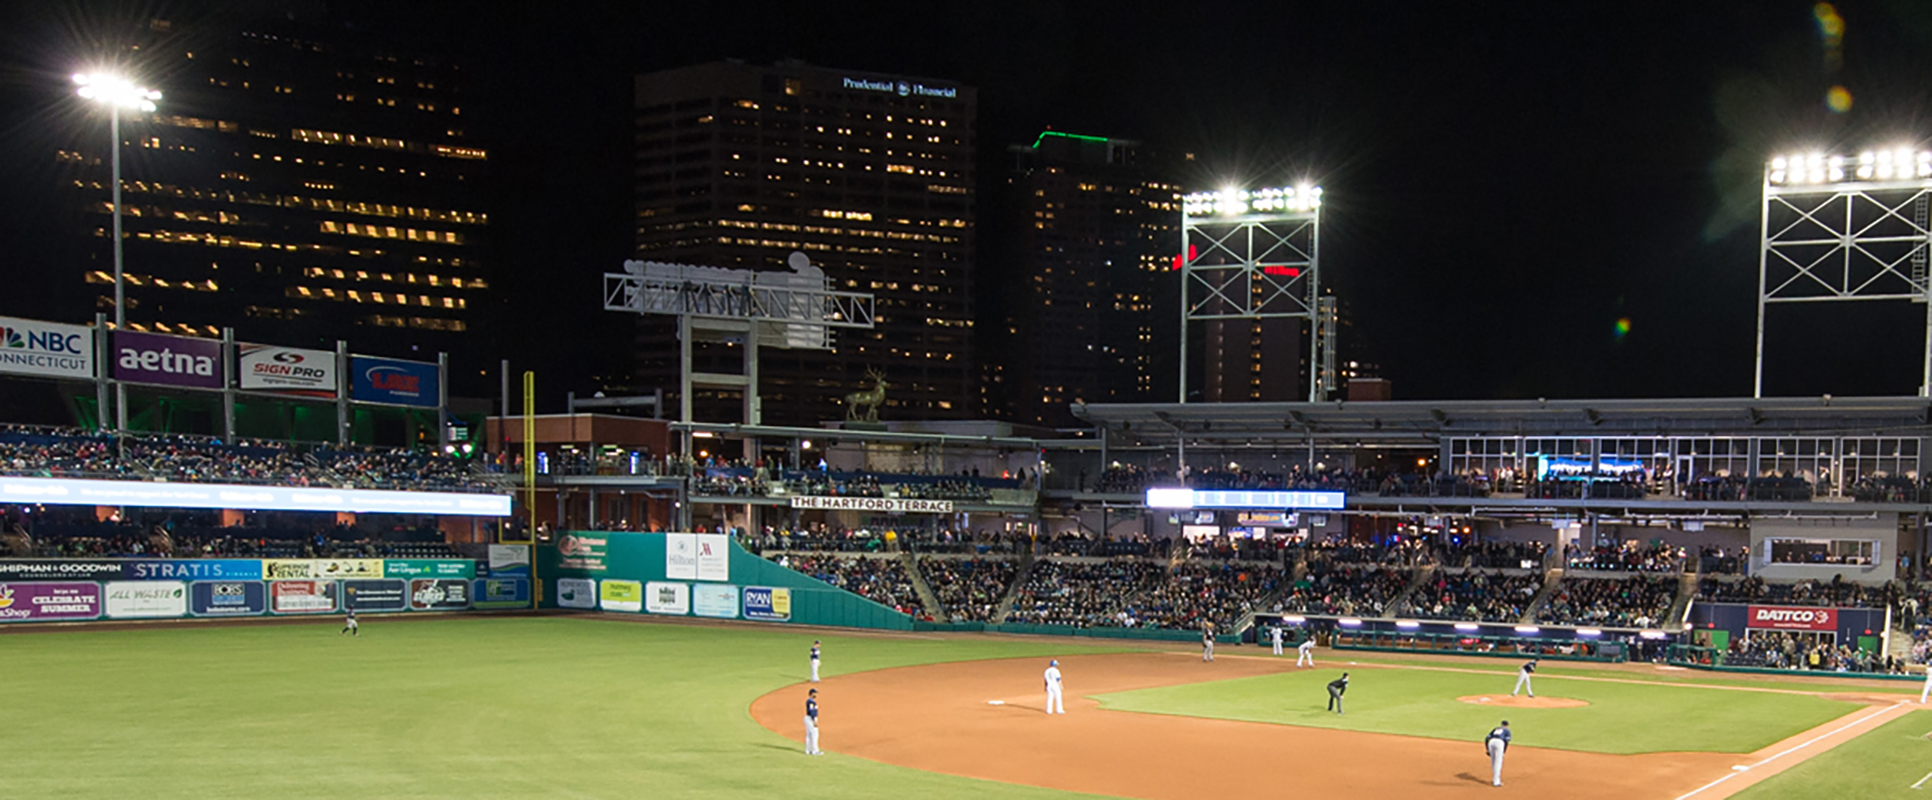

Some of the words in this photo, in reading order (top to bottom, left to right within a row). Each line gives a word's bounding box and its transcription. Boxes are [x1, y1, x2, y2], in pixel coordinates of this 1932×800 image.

[29, 330, 81, 354] NBC
[0, 353, 86, 370] NNECTICUT
[119, 347, 213, 376] aetna
[253, 362, 291, 375] SIGN
[292, 367, 325, 379] PRO
[793, 497, 817, 507] THE
[821, 498, 894, 509] HARTFORD
[897, 501, 952, 511] TERRACE
[59, 563, 122, 572] GOODWIN
[136, 563, 223, 577] STRATIS
[134, 589, 171, 599] WASTE
[746, 592, 771, 605] RYAN
[1756, 610, 1814, 622] DATTCO
